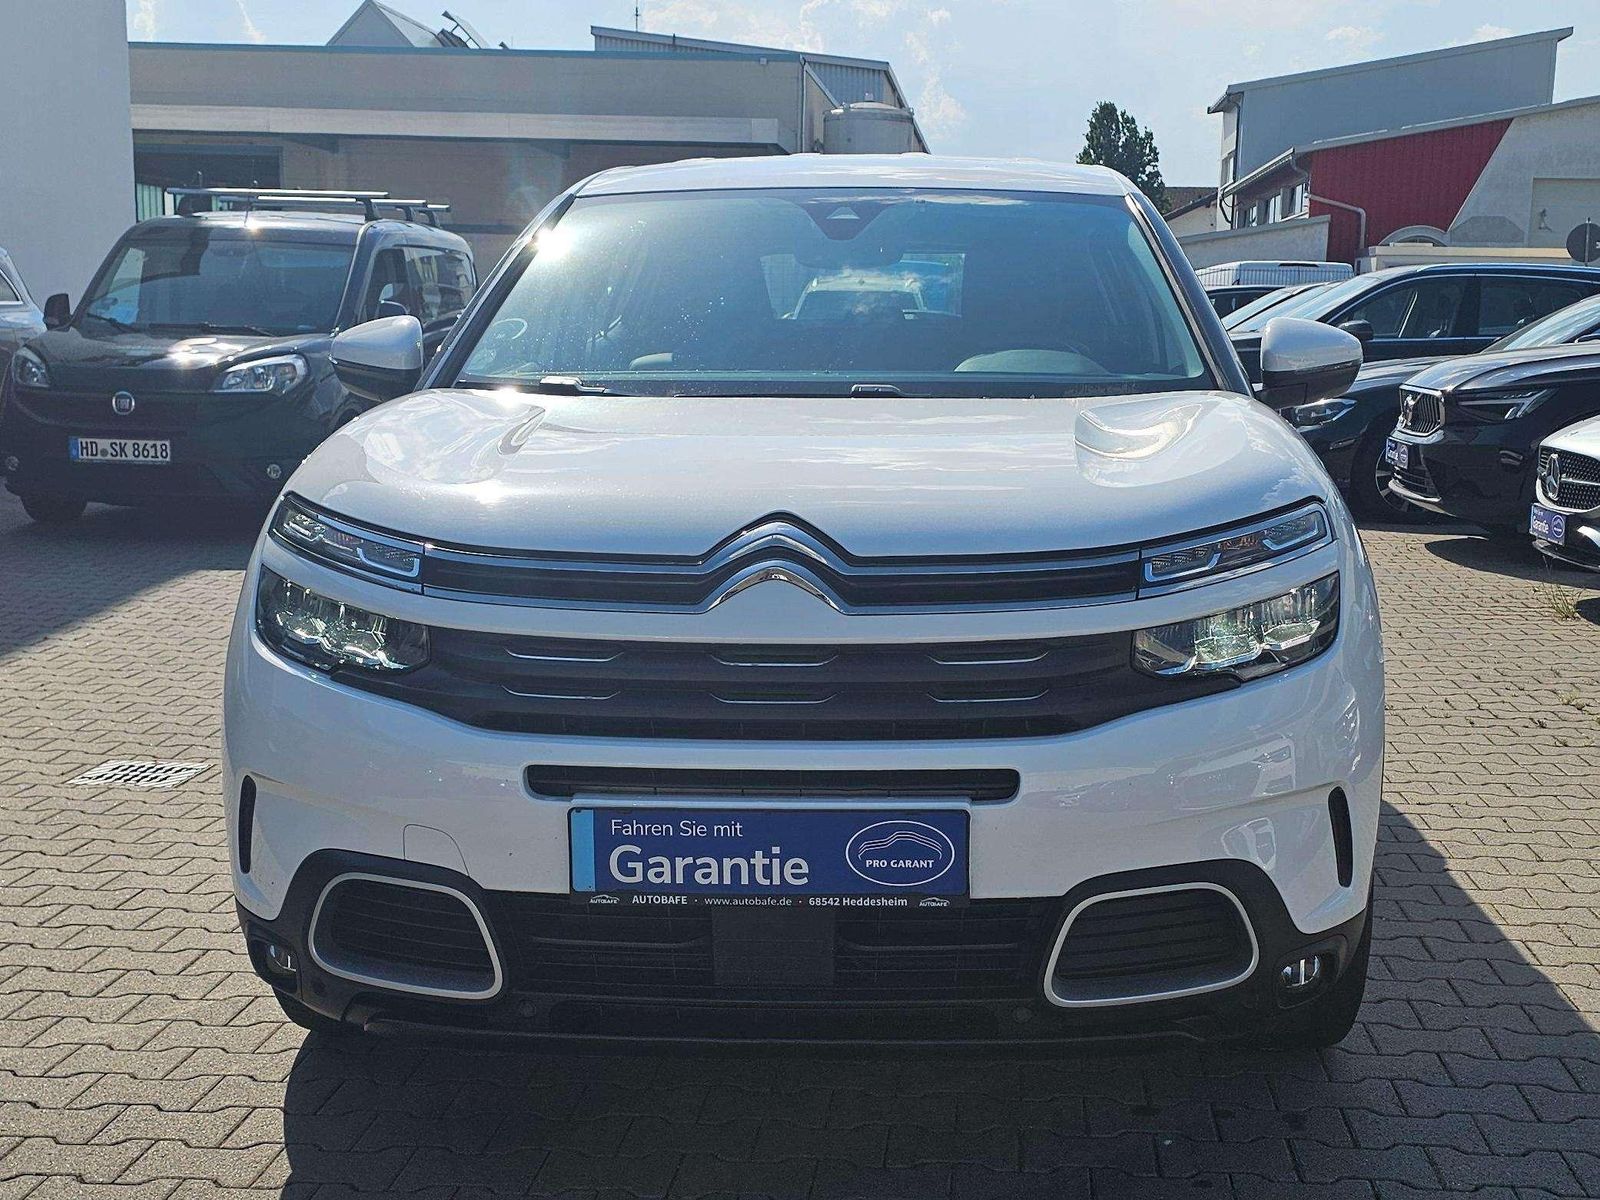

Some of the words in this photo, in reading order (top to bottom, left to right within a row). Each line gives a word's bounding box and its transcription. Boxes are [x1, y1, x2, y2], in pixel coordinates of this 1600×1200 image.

[80, 441, 98, 457] HD
[110, 442, 128, 458] SK
[132, 442, 168, 459] 8618
[611, 819, 673, 836] Fahren
[679, 820, 707, 837] Sie
[714, 821, 743, 837] mit
[609, 844, 809, 885] Garantie
[865, 859, 888, 868] PRO
[890, 859, 935, 868] GARANT
[632, 895, 688, 905] AUTOBAFE
[704, 897, 793, 906] www.autobafe.de
[808, 897, 840, 906] 68542
[842, 897, 908, 907] Heddesheim
